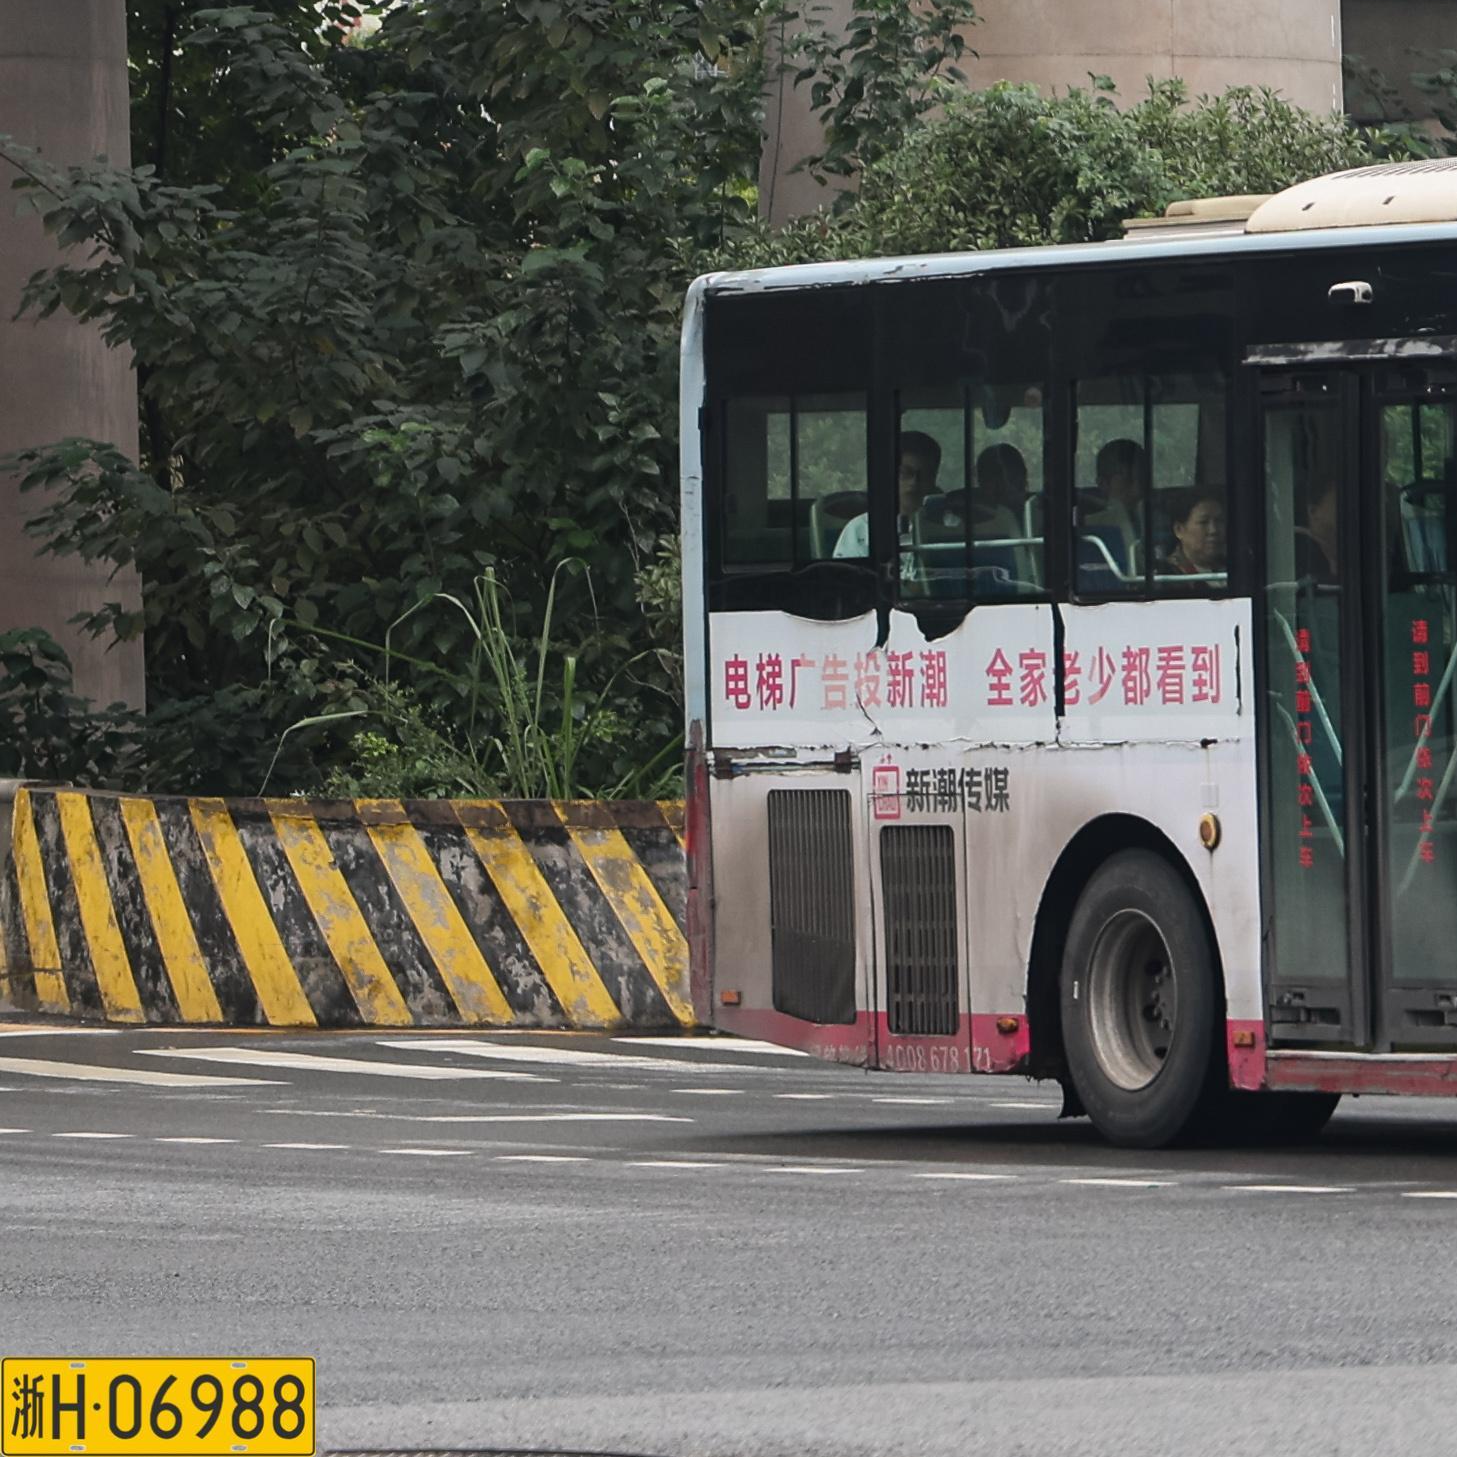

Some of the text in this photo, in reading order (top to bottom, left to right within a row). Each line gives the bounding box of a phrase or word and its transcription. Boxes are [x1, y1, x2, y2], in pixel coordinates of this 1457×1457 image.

[724, 643, 1222, 712] 电梯广告投新潮 全家老少都看到
[905, 767, 1009, 813] 新潮传媒
